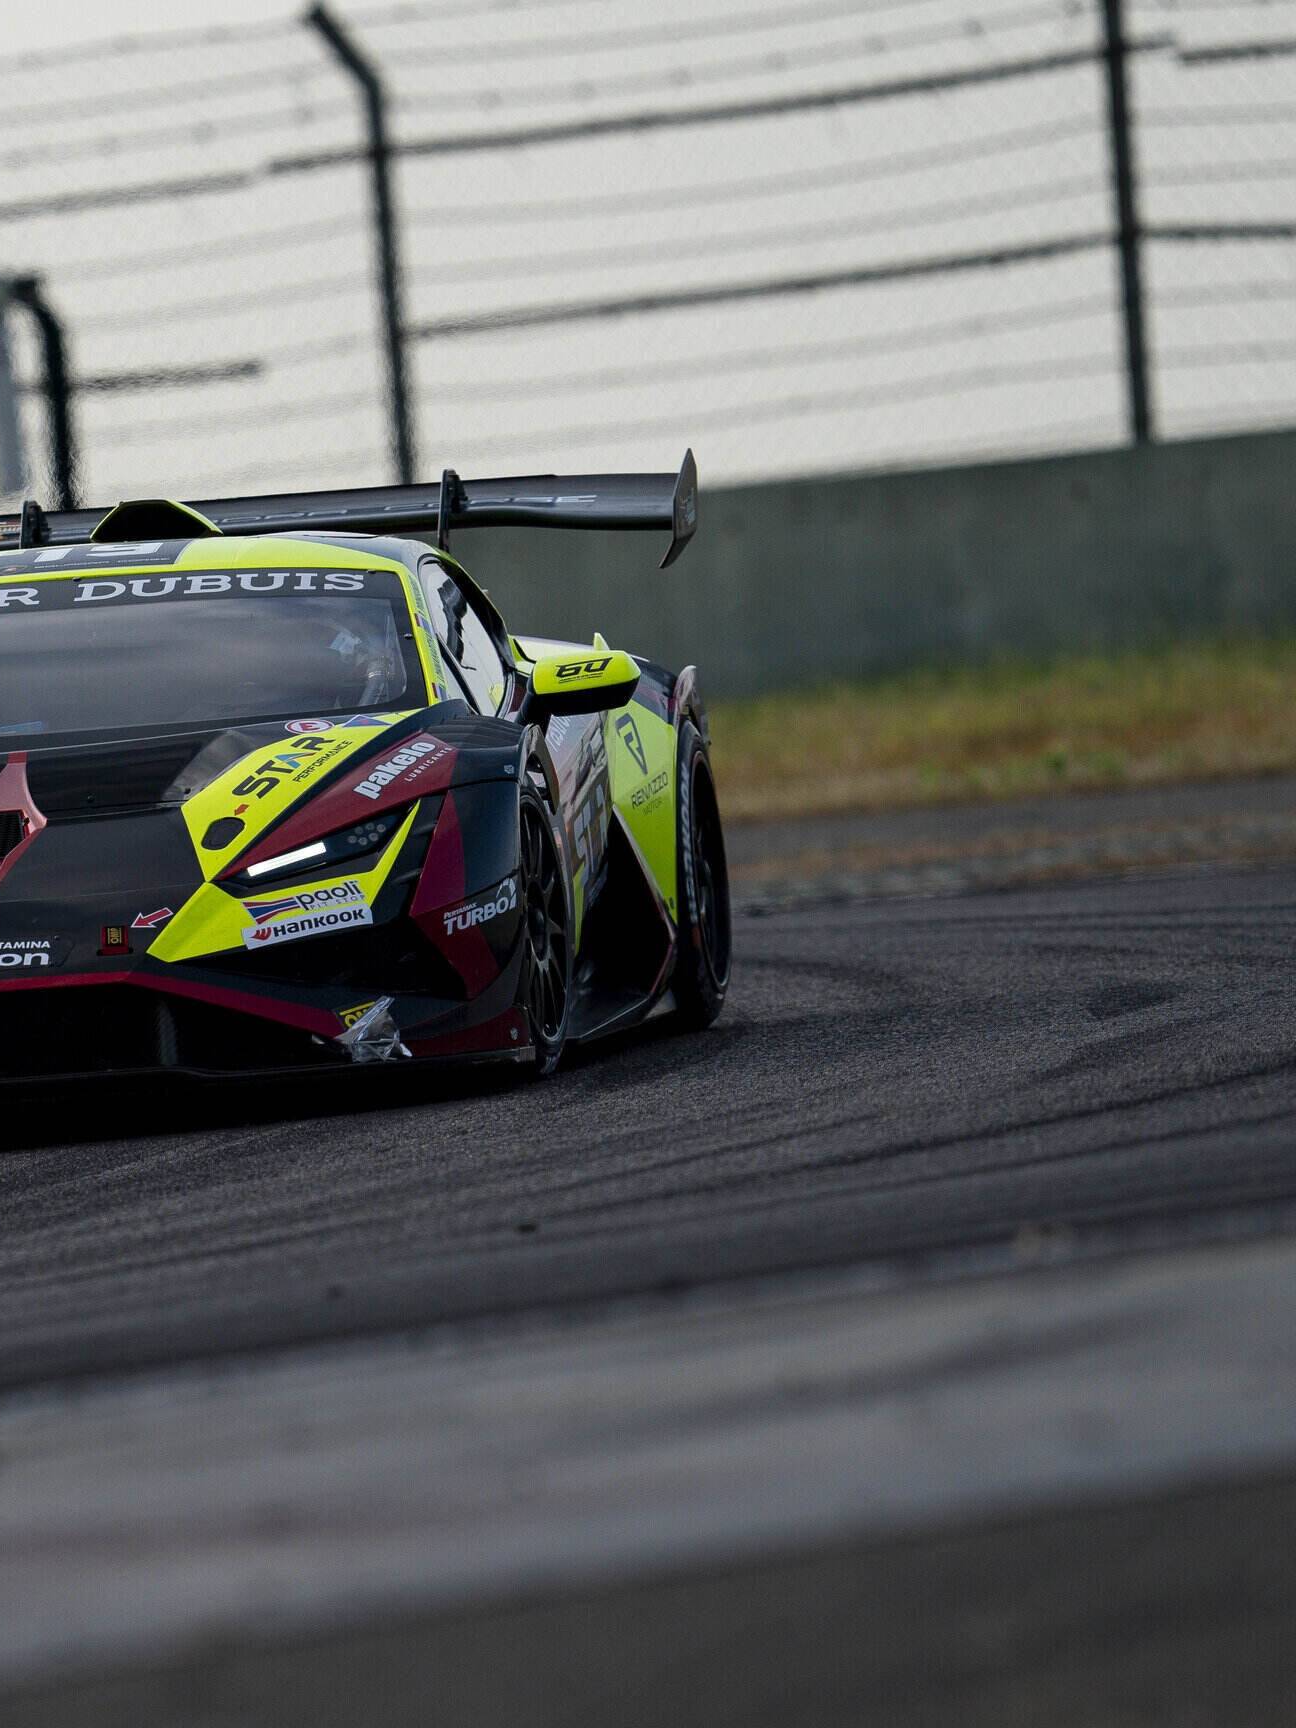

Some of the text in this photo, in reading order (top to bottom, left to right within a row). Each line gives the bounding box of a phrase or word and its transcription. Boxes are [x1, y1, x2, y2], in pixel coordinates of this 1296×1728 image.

[73, 572, 366, 604] DUBUIS
[232, 736, 336, 799] STAR
[292, 740, 354, 783] PERFORMANCE
[353, 742, 436, 800] pakelo
[296, 880, 362, 911] paoli
[444, 896, 509, 936] TURBO
